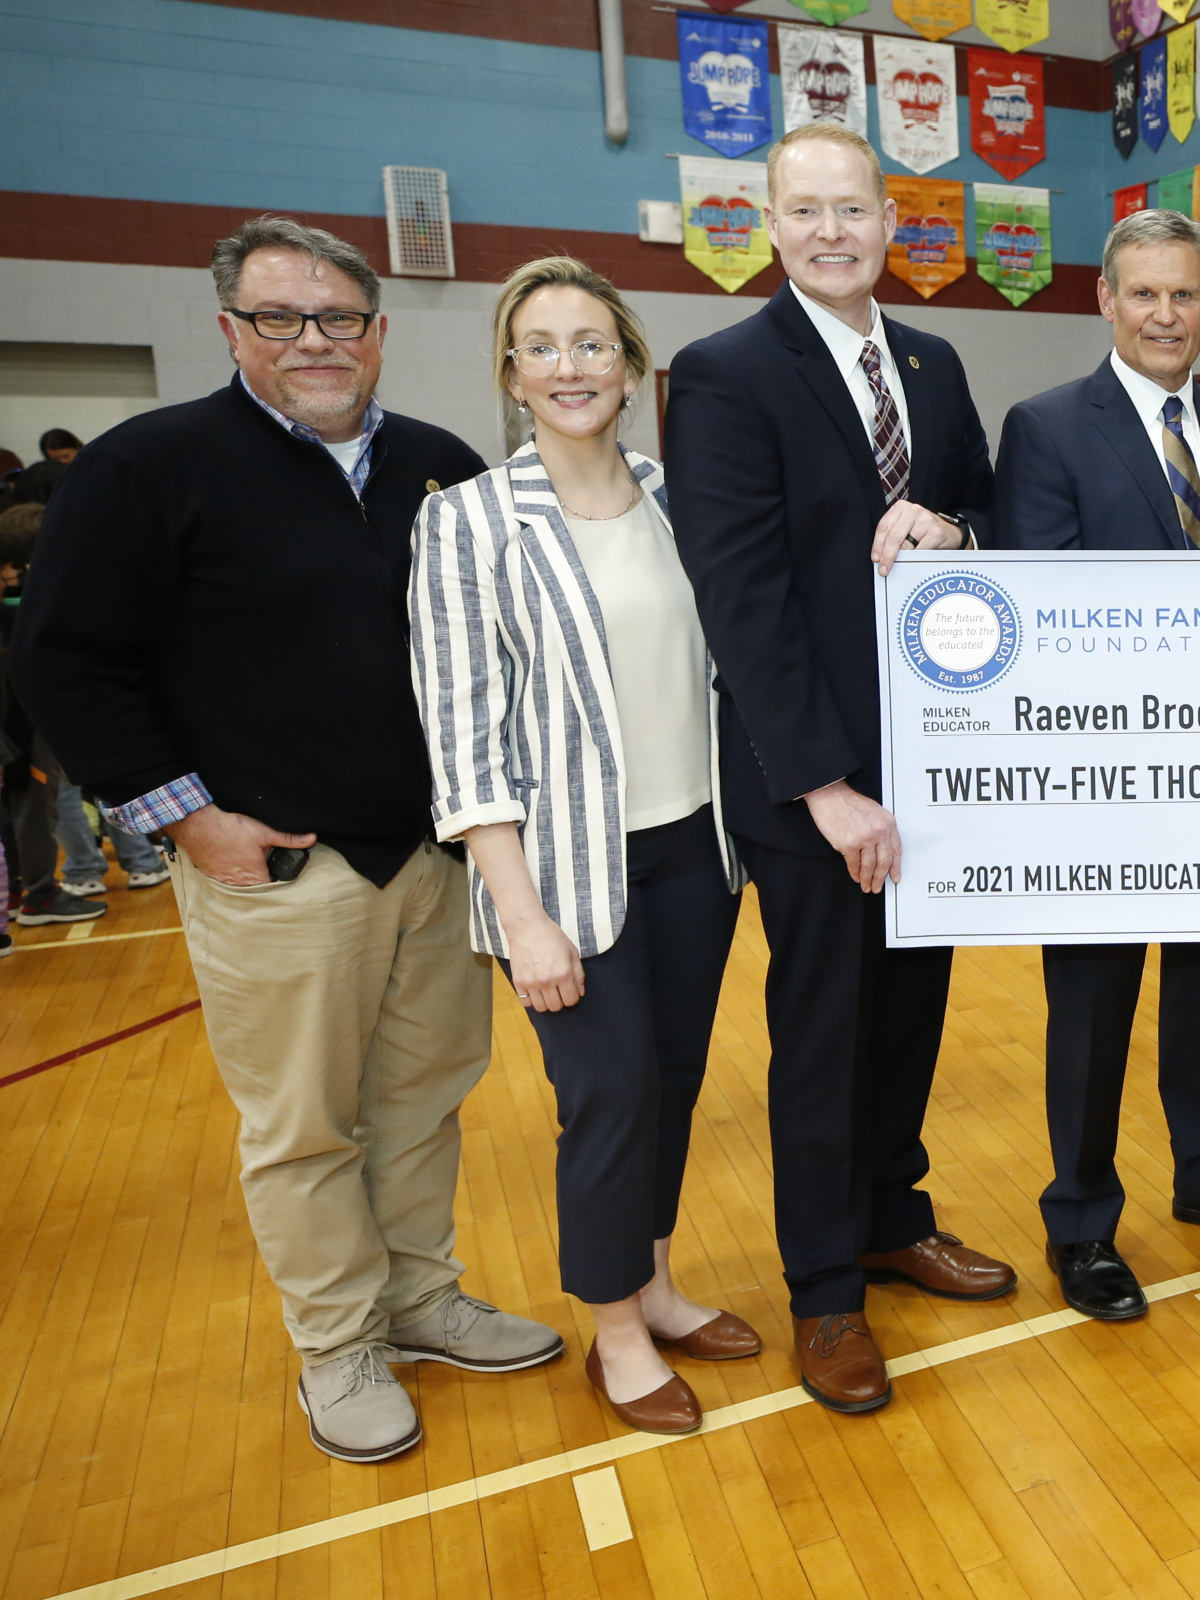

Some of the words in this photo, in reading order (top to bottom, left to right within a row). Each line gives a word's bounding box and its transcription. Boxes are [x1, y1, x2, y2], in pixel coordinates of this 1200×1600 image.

[688, 62, 726, 85] JUMP
[728, 65, 761, 88] ROPE
[882, 80, 918, 103] JUMP
[918, 82, 950, 106] ROPE
[907, 607, 927, 665] MILKEN
[918, 580, 995, 606] EDUCATOR
[994, 603, 1013, 664] AWARDS
[935, 613, 952, 622] The
[955, 613, 985, 625] future
[1037, 609, 1142, 628] MILKEN
[926, 627, 963, 638] belongs
[966, 627, 978, 636] to
[979, 626, 995, 636] the
[939, 640, 983, 650] educated
[938, 671, 956, 683] Est.
[962, 671, 984, 684] 1987
[923, 707, 971, 718] MILKEN
[1014, 696, 1128, 731] Raeven
[923, 720, 991, 732] EDUCATOR
[926, 766, 1136, 802] TWENTY-FIVE
[928, 881, 956, 893] FOR
[963, 866, 1013, 892] 2021
[1025, 864, 1112, 891] MILKEN
